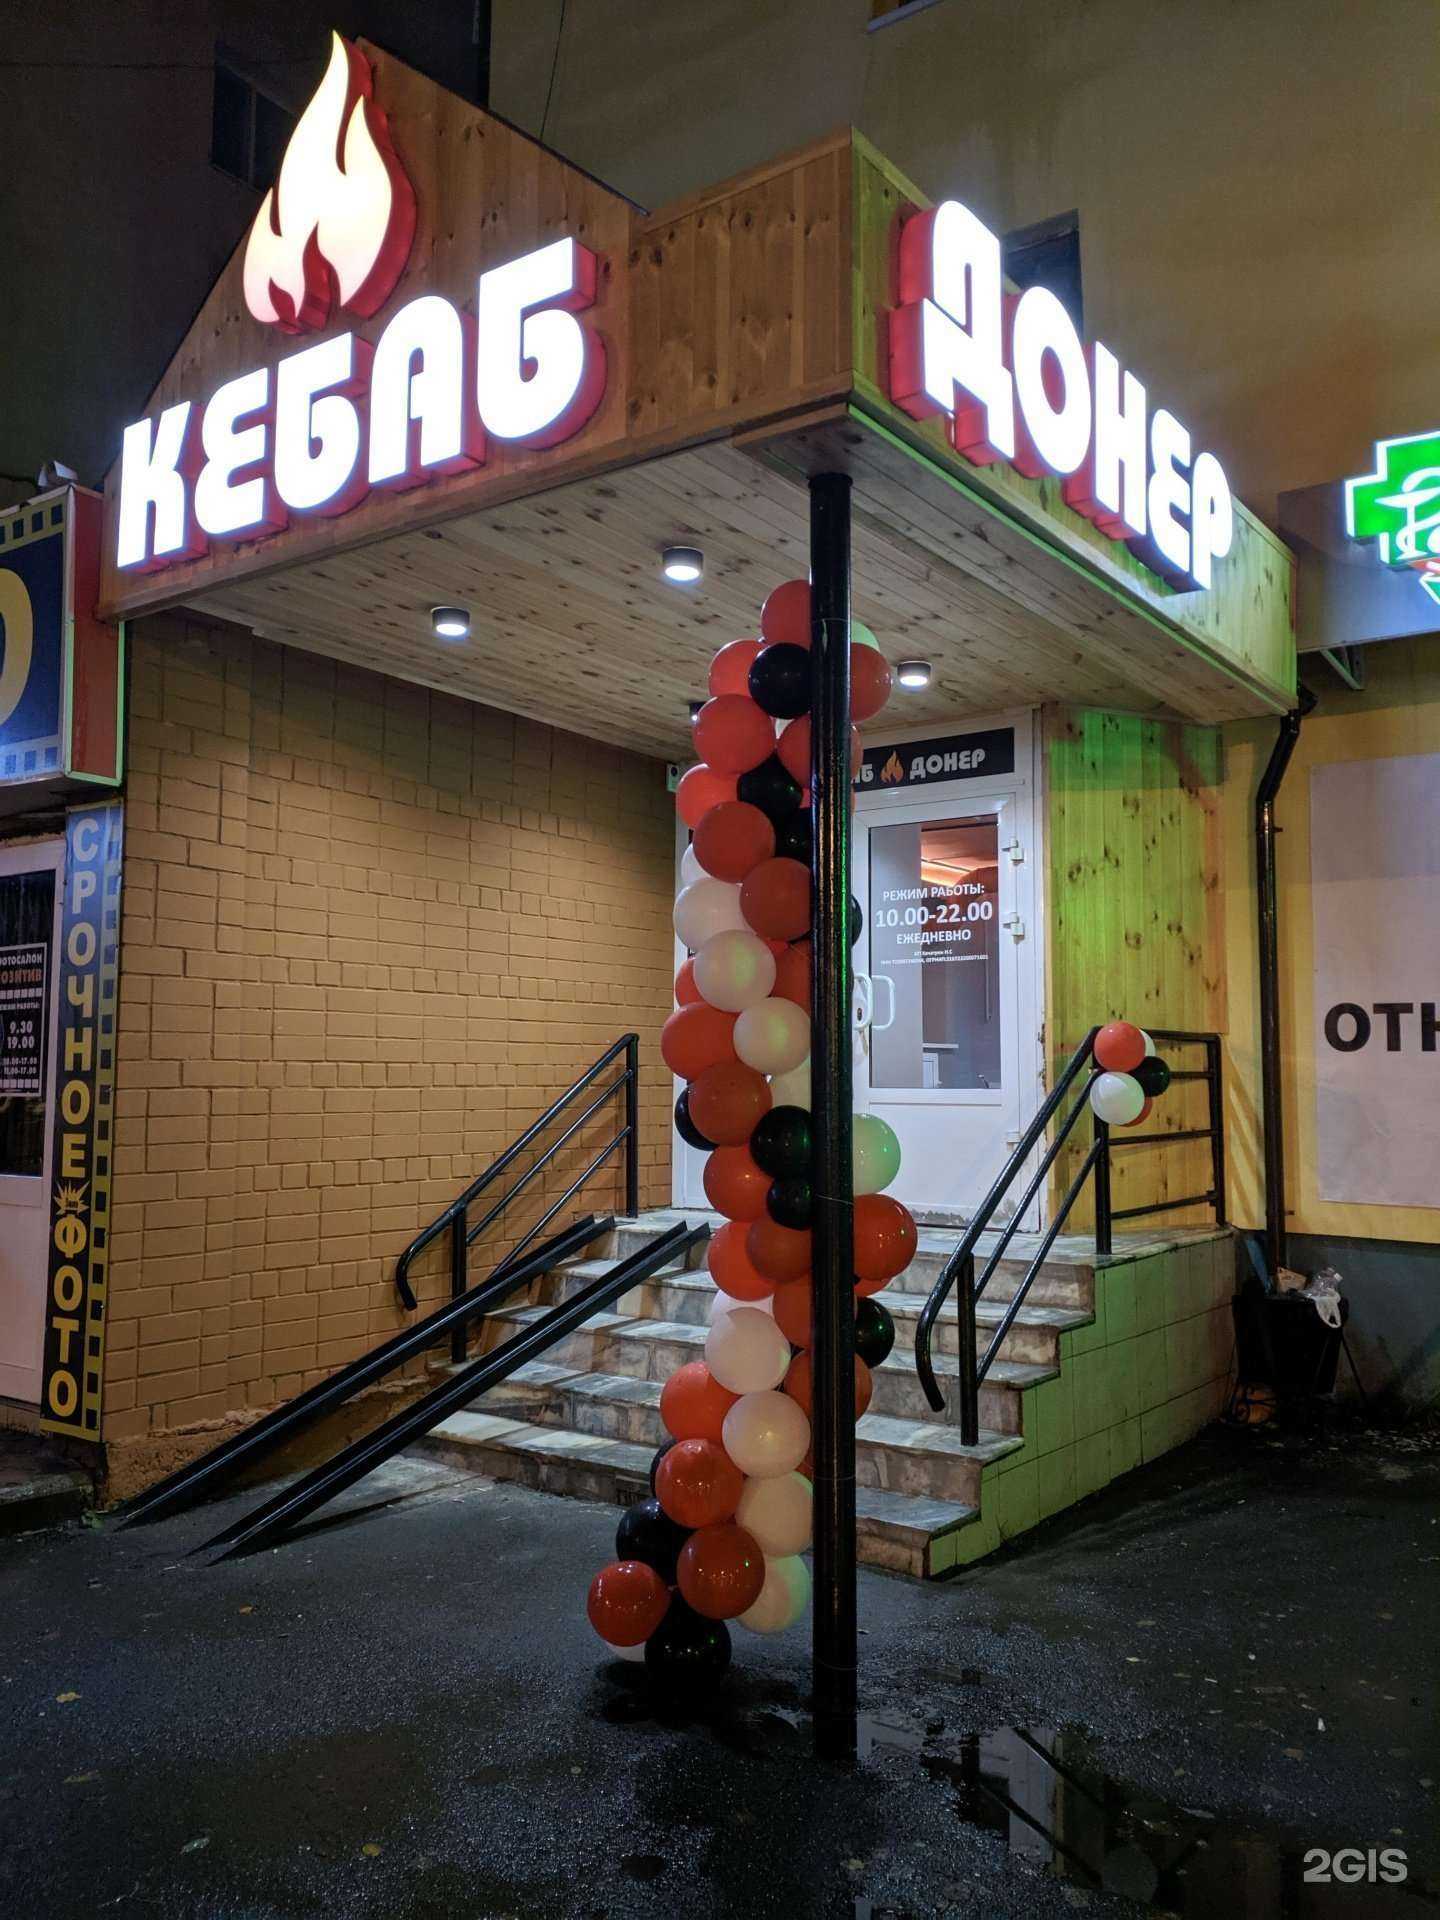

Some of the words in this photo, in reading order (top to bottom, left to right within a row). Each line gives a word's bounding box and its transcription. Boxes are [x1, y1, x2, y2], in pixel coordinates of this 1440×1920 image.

[117, 236, 585, 568] КЕБАБ
[923, 200, 1233, 590] ДОНЕР
[910, 748, 986, 780] ДОНЕР
[883, 886, 928, 902] РЕЖИМ
[930, 883, 985, 899] РАБОТЫ:
[875, 901, 993, 928] 10.00-22.00
[896, 928, 971, 945] ЕЖЕДНЕВНО
[0, 969, 42, 984] ОЗИТИВ
[61, 817, 100, 1178] СРОЧНОЕ
[10, 1020, 33, 1034] 9.30
[7, 1036, 35, 1049] 19.00
[49, 1213, 87, 1417] ФОТО
